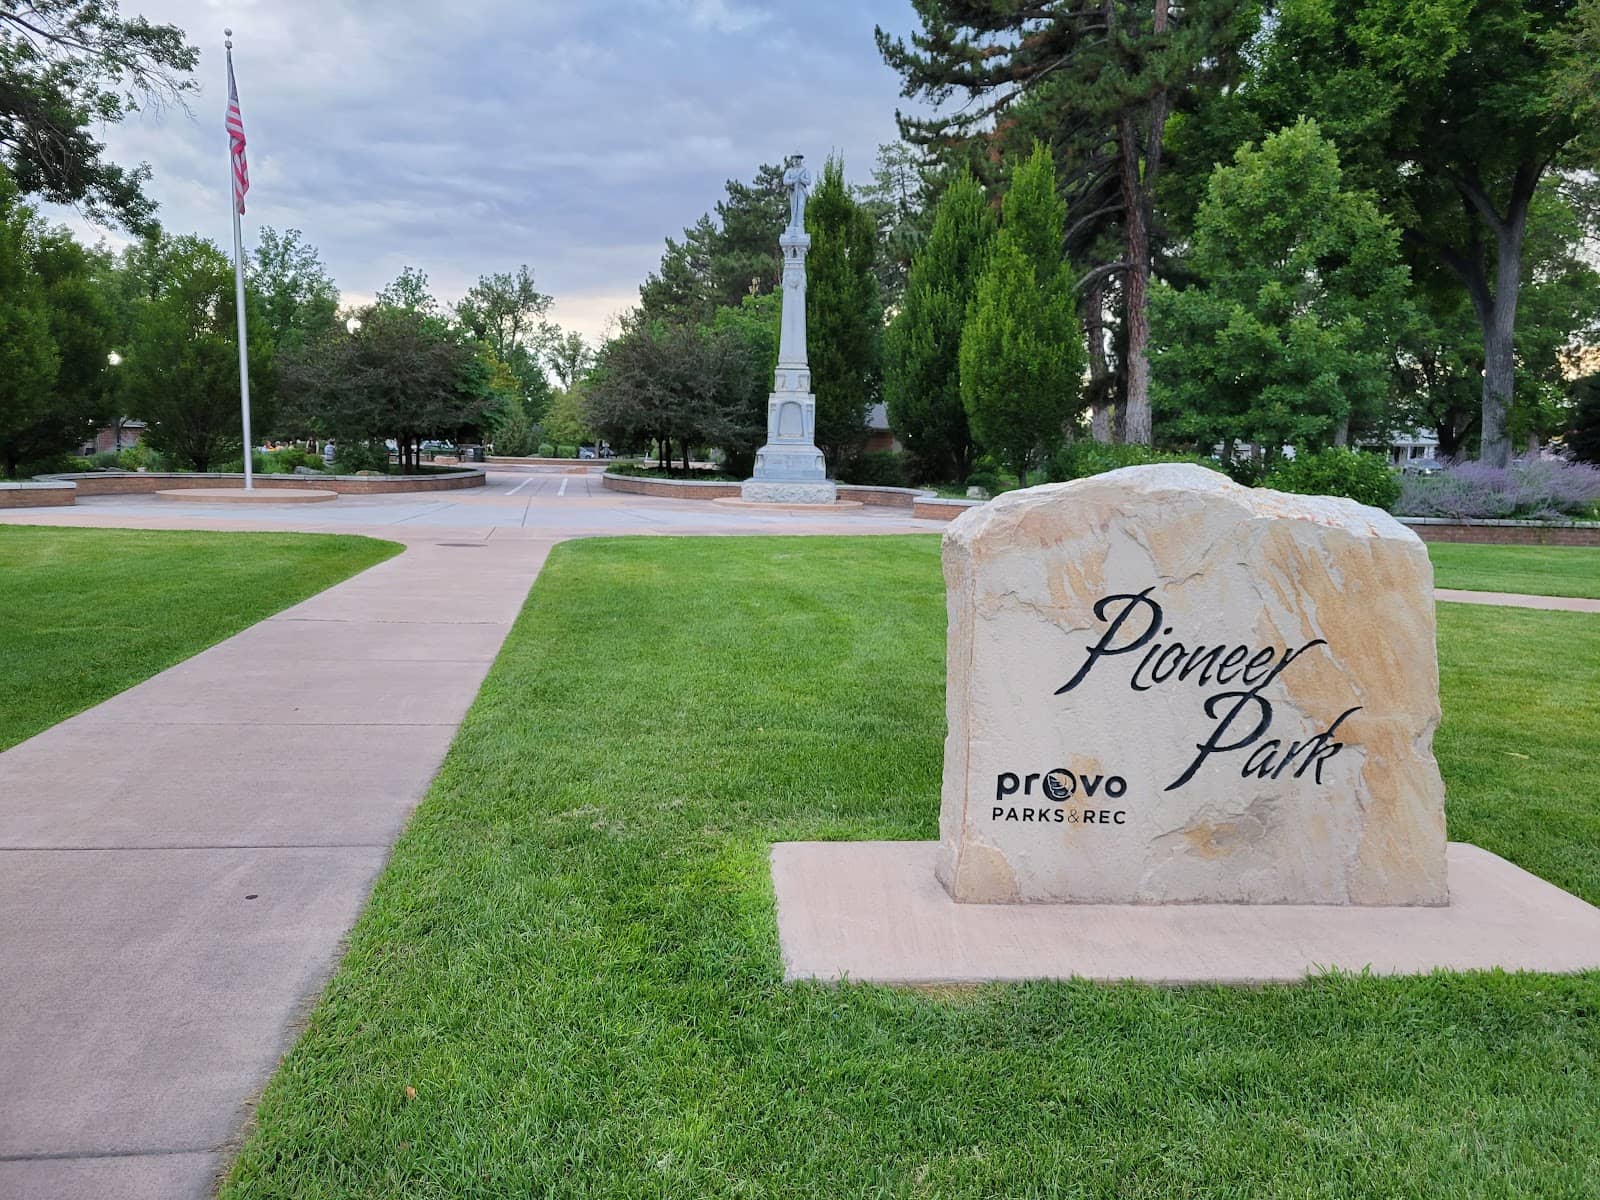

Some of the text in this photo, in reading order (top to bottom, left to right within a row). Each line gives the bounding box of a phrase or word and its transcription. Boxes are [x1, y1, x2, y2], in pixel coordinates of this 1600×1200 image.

[1053, 586, 1328, 696] Pioneer
[996, 768, 1128, 802] provo
[1163, 687, 1364, 792] Park
